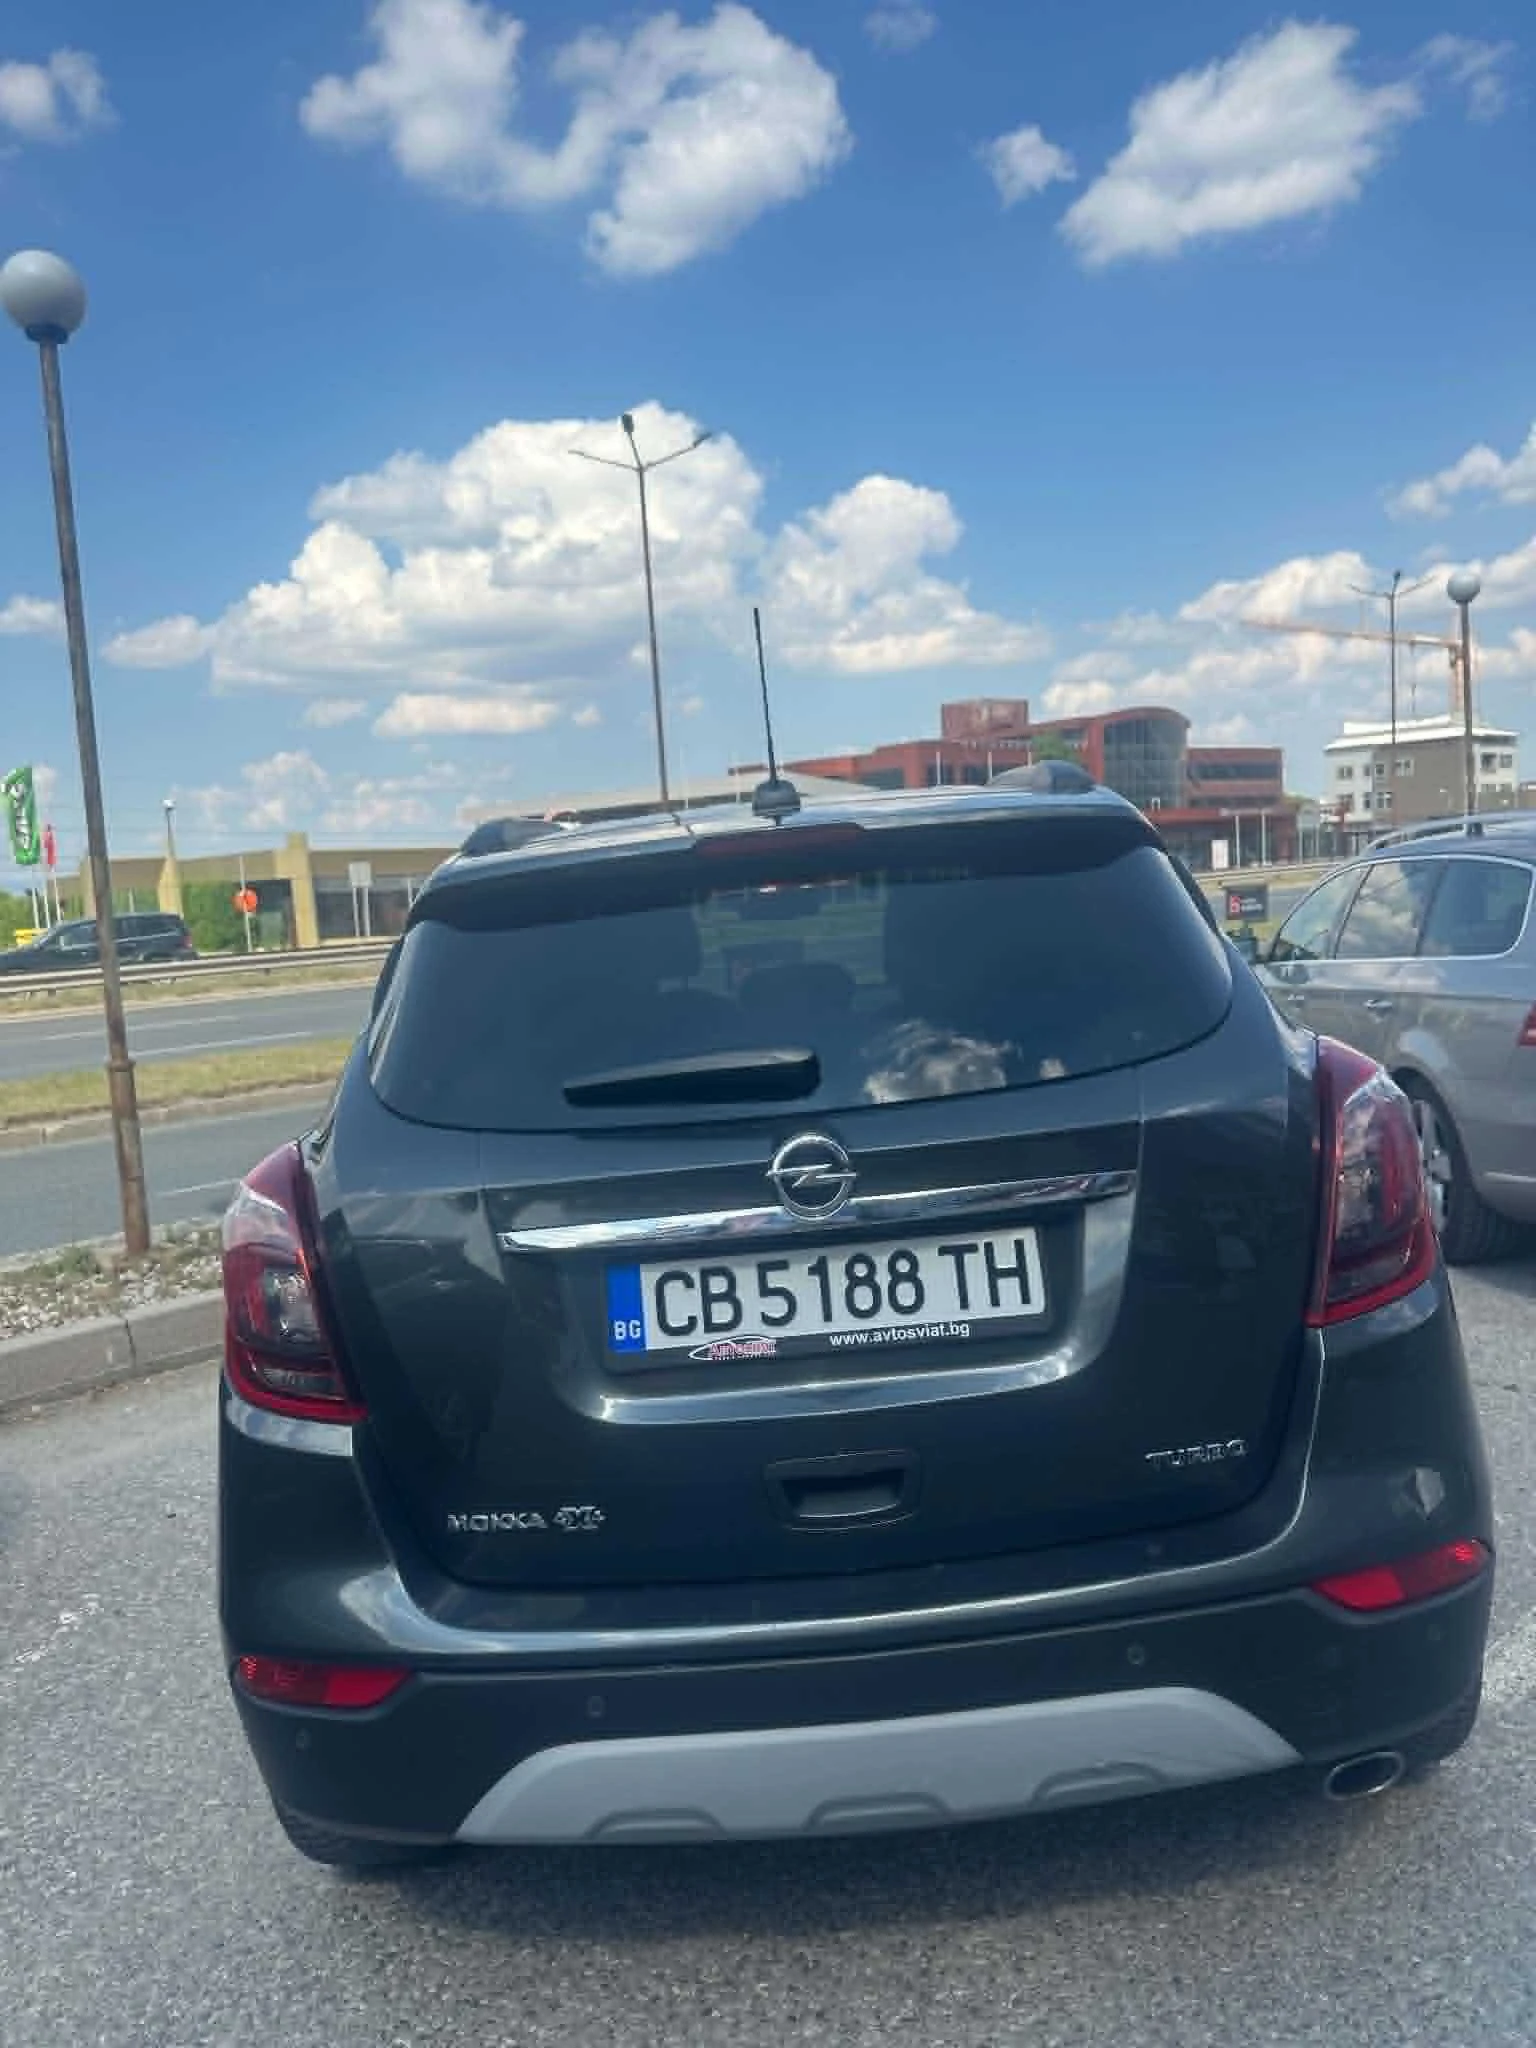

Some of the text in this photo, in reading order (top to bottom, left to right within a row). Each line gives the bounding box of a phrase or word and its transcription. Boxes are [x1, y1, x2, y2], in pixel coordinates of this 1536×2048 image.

[655, 1239, 1032, 1337] CB 5188 TH
[613, 1320, 641, 1340] BG
[829, 1321, 970, 1345] www.avtosviat.bg
[1145, 1439, 1247, 1471] TURBO
[447, 1511, 548, 1532] MOKKA
